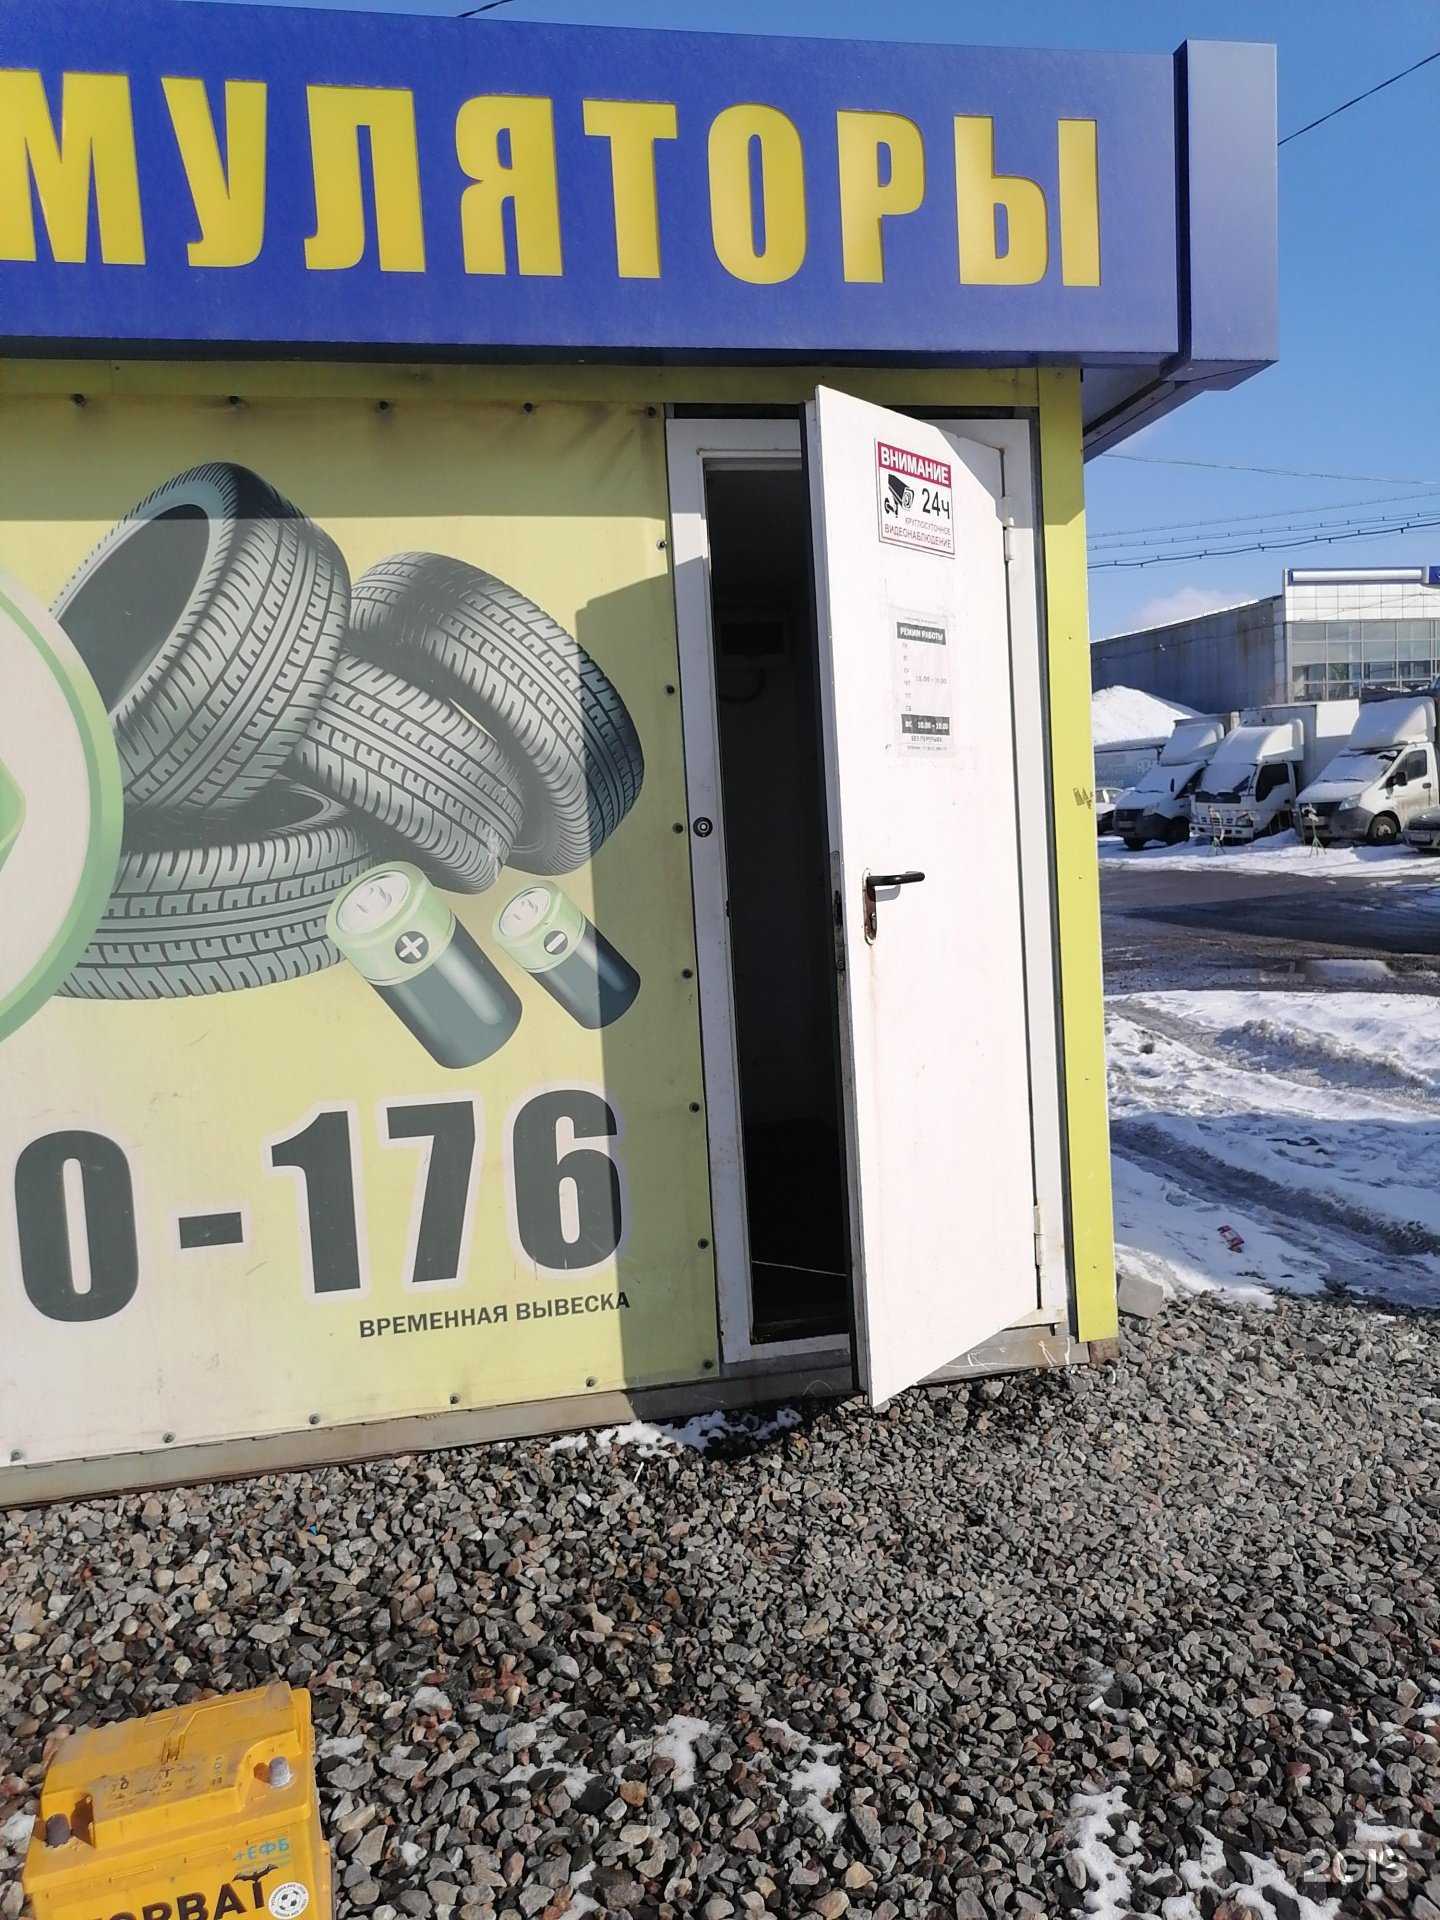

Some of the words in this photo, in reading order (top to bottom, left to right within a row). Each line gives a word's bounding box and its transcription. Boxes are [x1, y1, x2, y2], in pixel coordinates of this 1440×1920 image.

[0, 69, 1101, 288] МУЛЯТОРЫ
[880, 446, 950, 485] ВНИМАНИЕ
[884, 524, 952, 549] ВИДЕОНАБЛЮДЕНИЕ
[900, 626, 921, 637] РЕЖИМ
[921, 630, 943, 641] РАБОТЫ
[359, 1305, 509, 1339] ВРЕМЕННАЯ
[516, 1291, 630, 1322] ВЫВЕСКА
